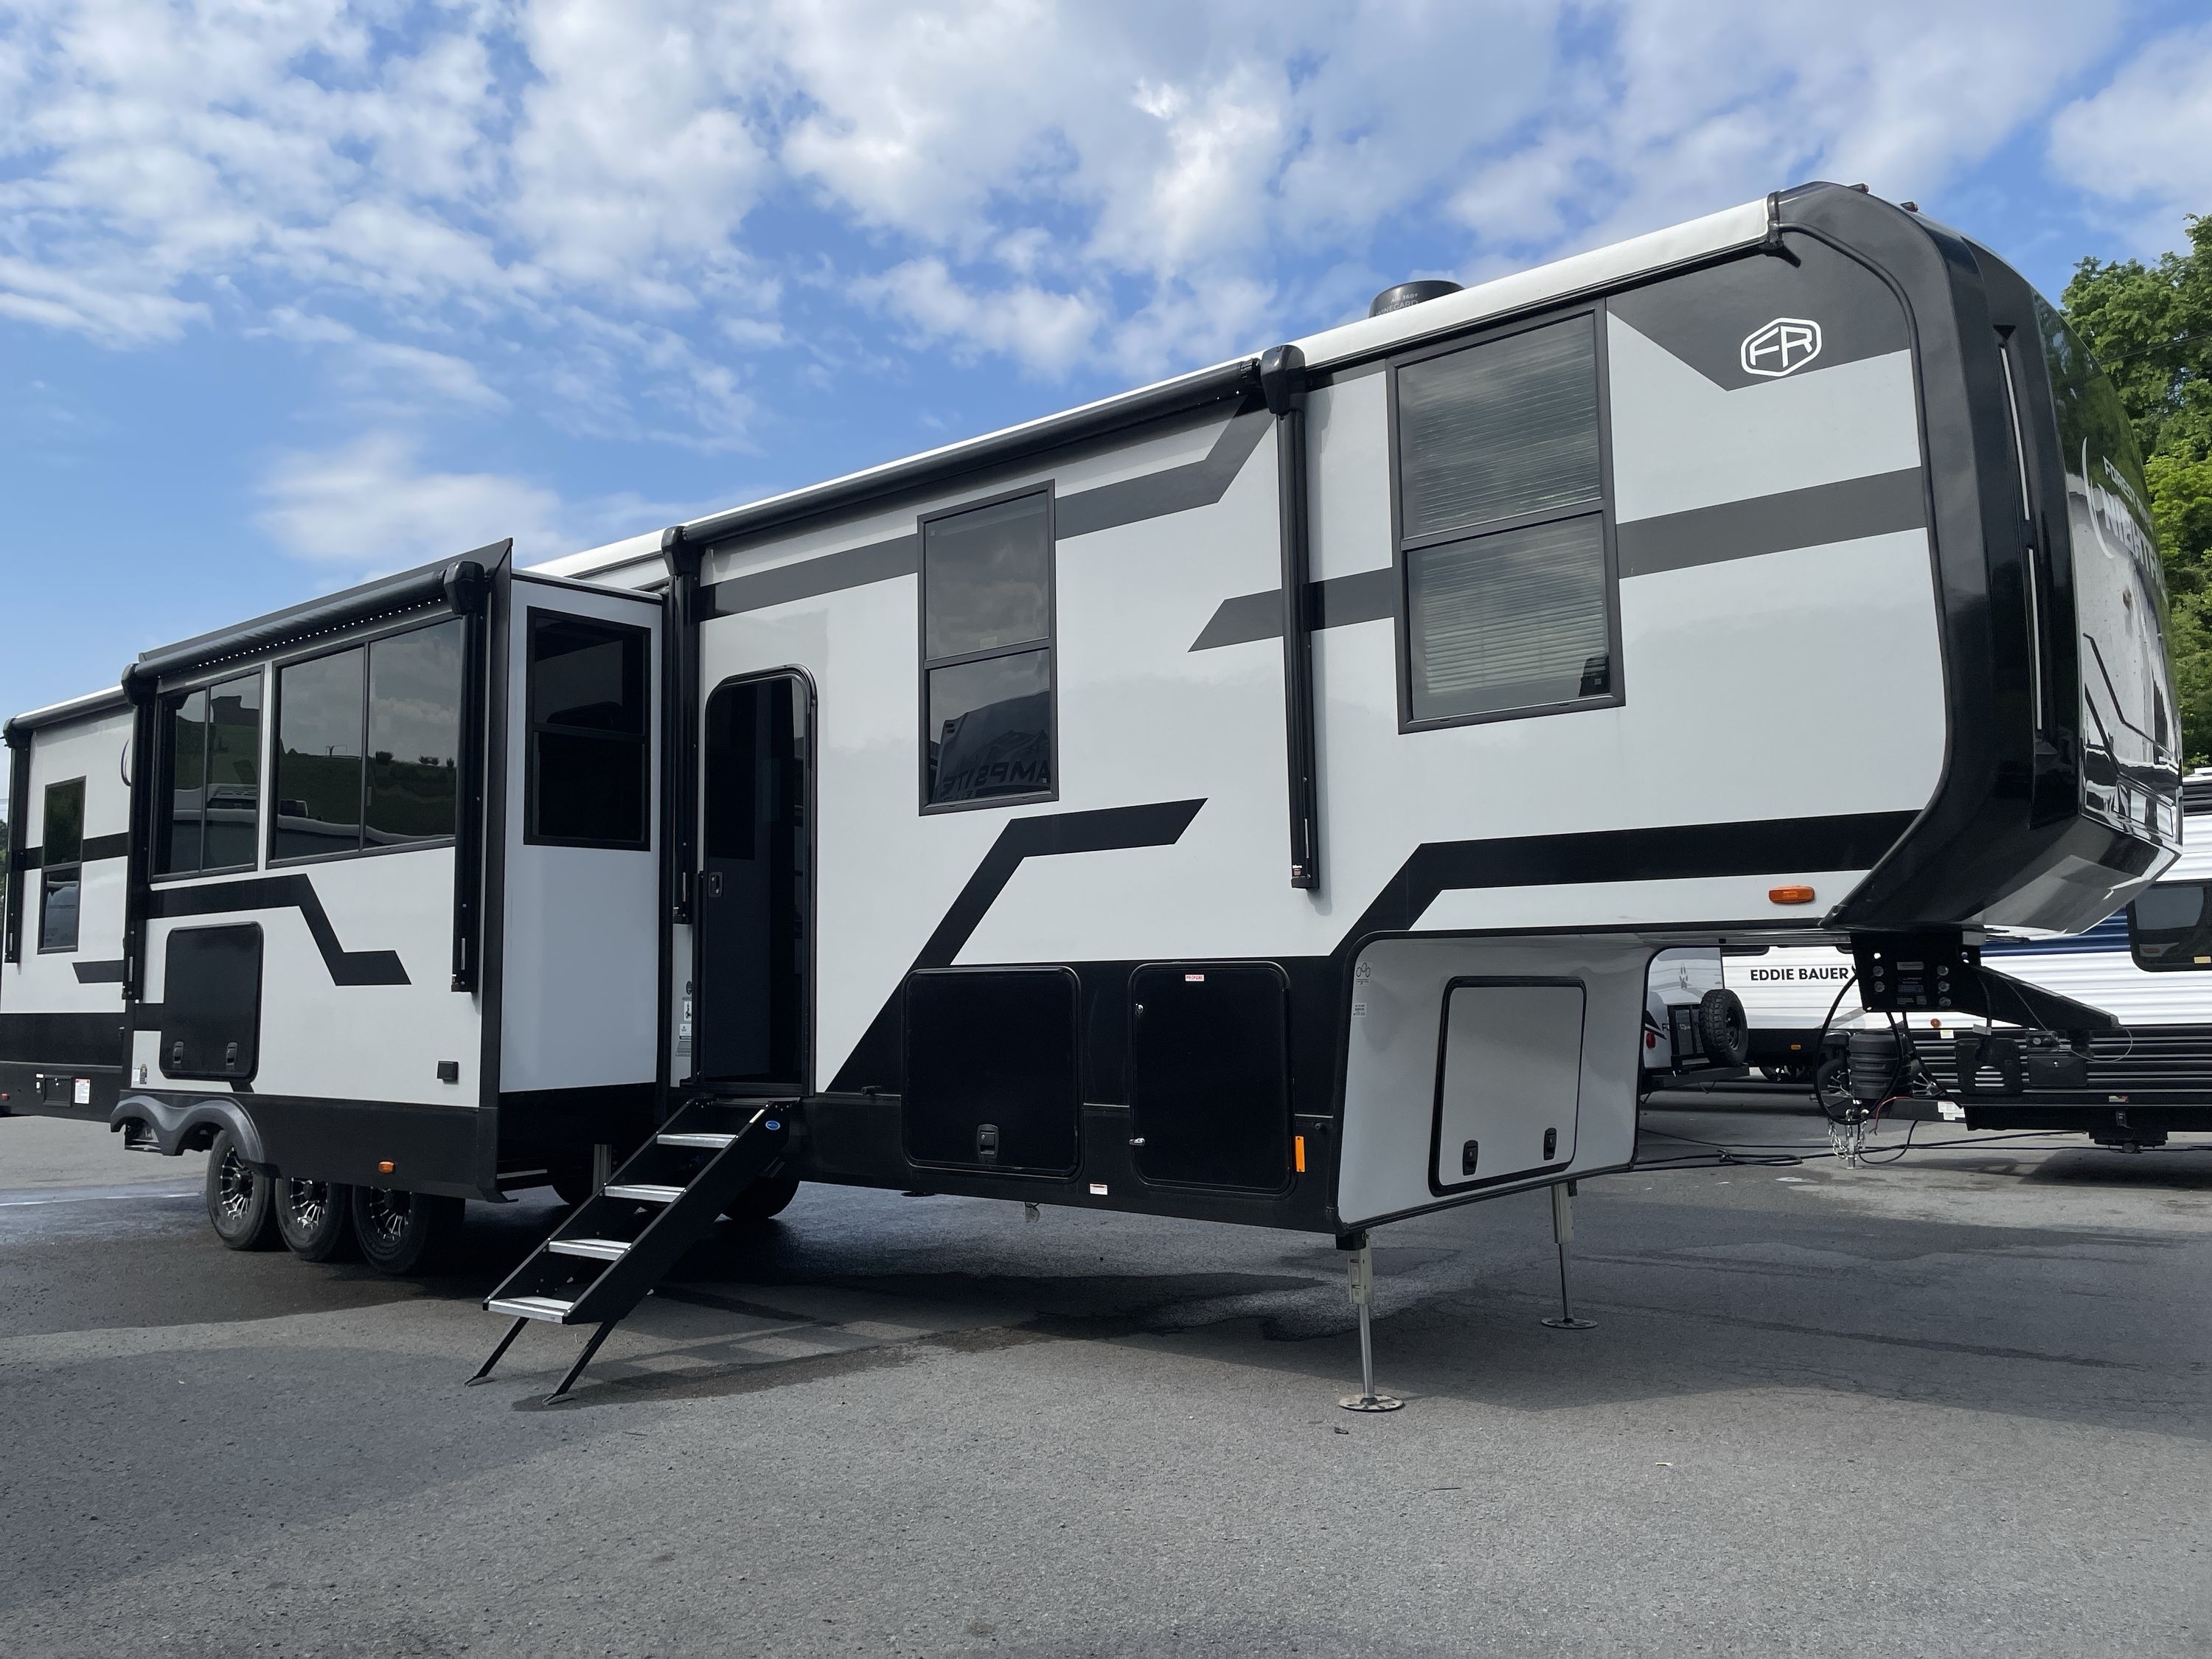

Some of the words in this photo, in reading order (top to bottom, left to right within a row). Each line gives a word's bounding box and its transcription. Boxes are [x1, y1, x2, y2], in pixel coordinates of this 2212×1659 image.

[1376, 299, 1419, 316] WINEGARD
[1749, 325, 1813, 369] FR
[2103, 455, 2138, 509] FOREST
[1750, 968, 1795, 981] EDDIE
[1798, 967, 1849, 981] BAUER
